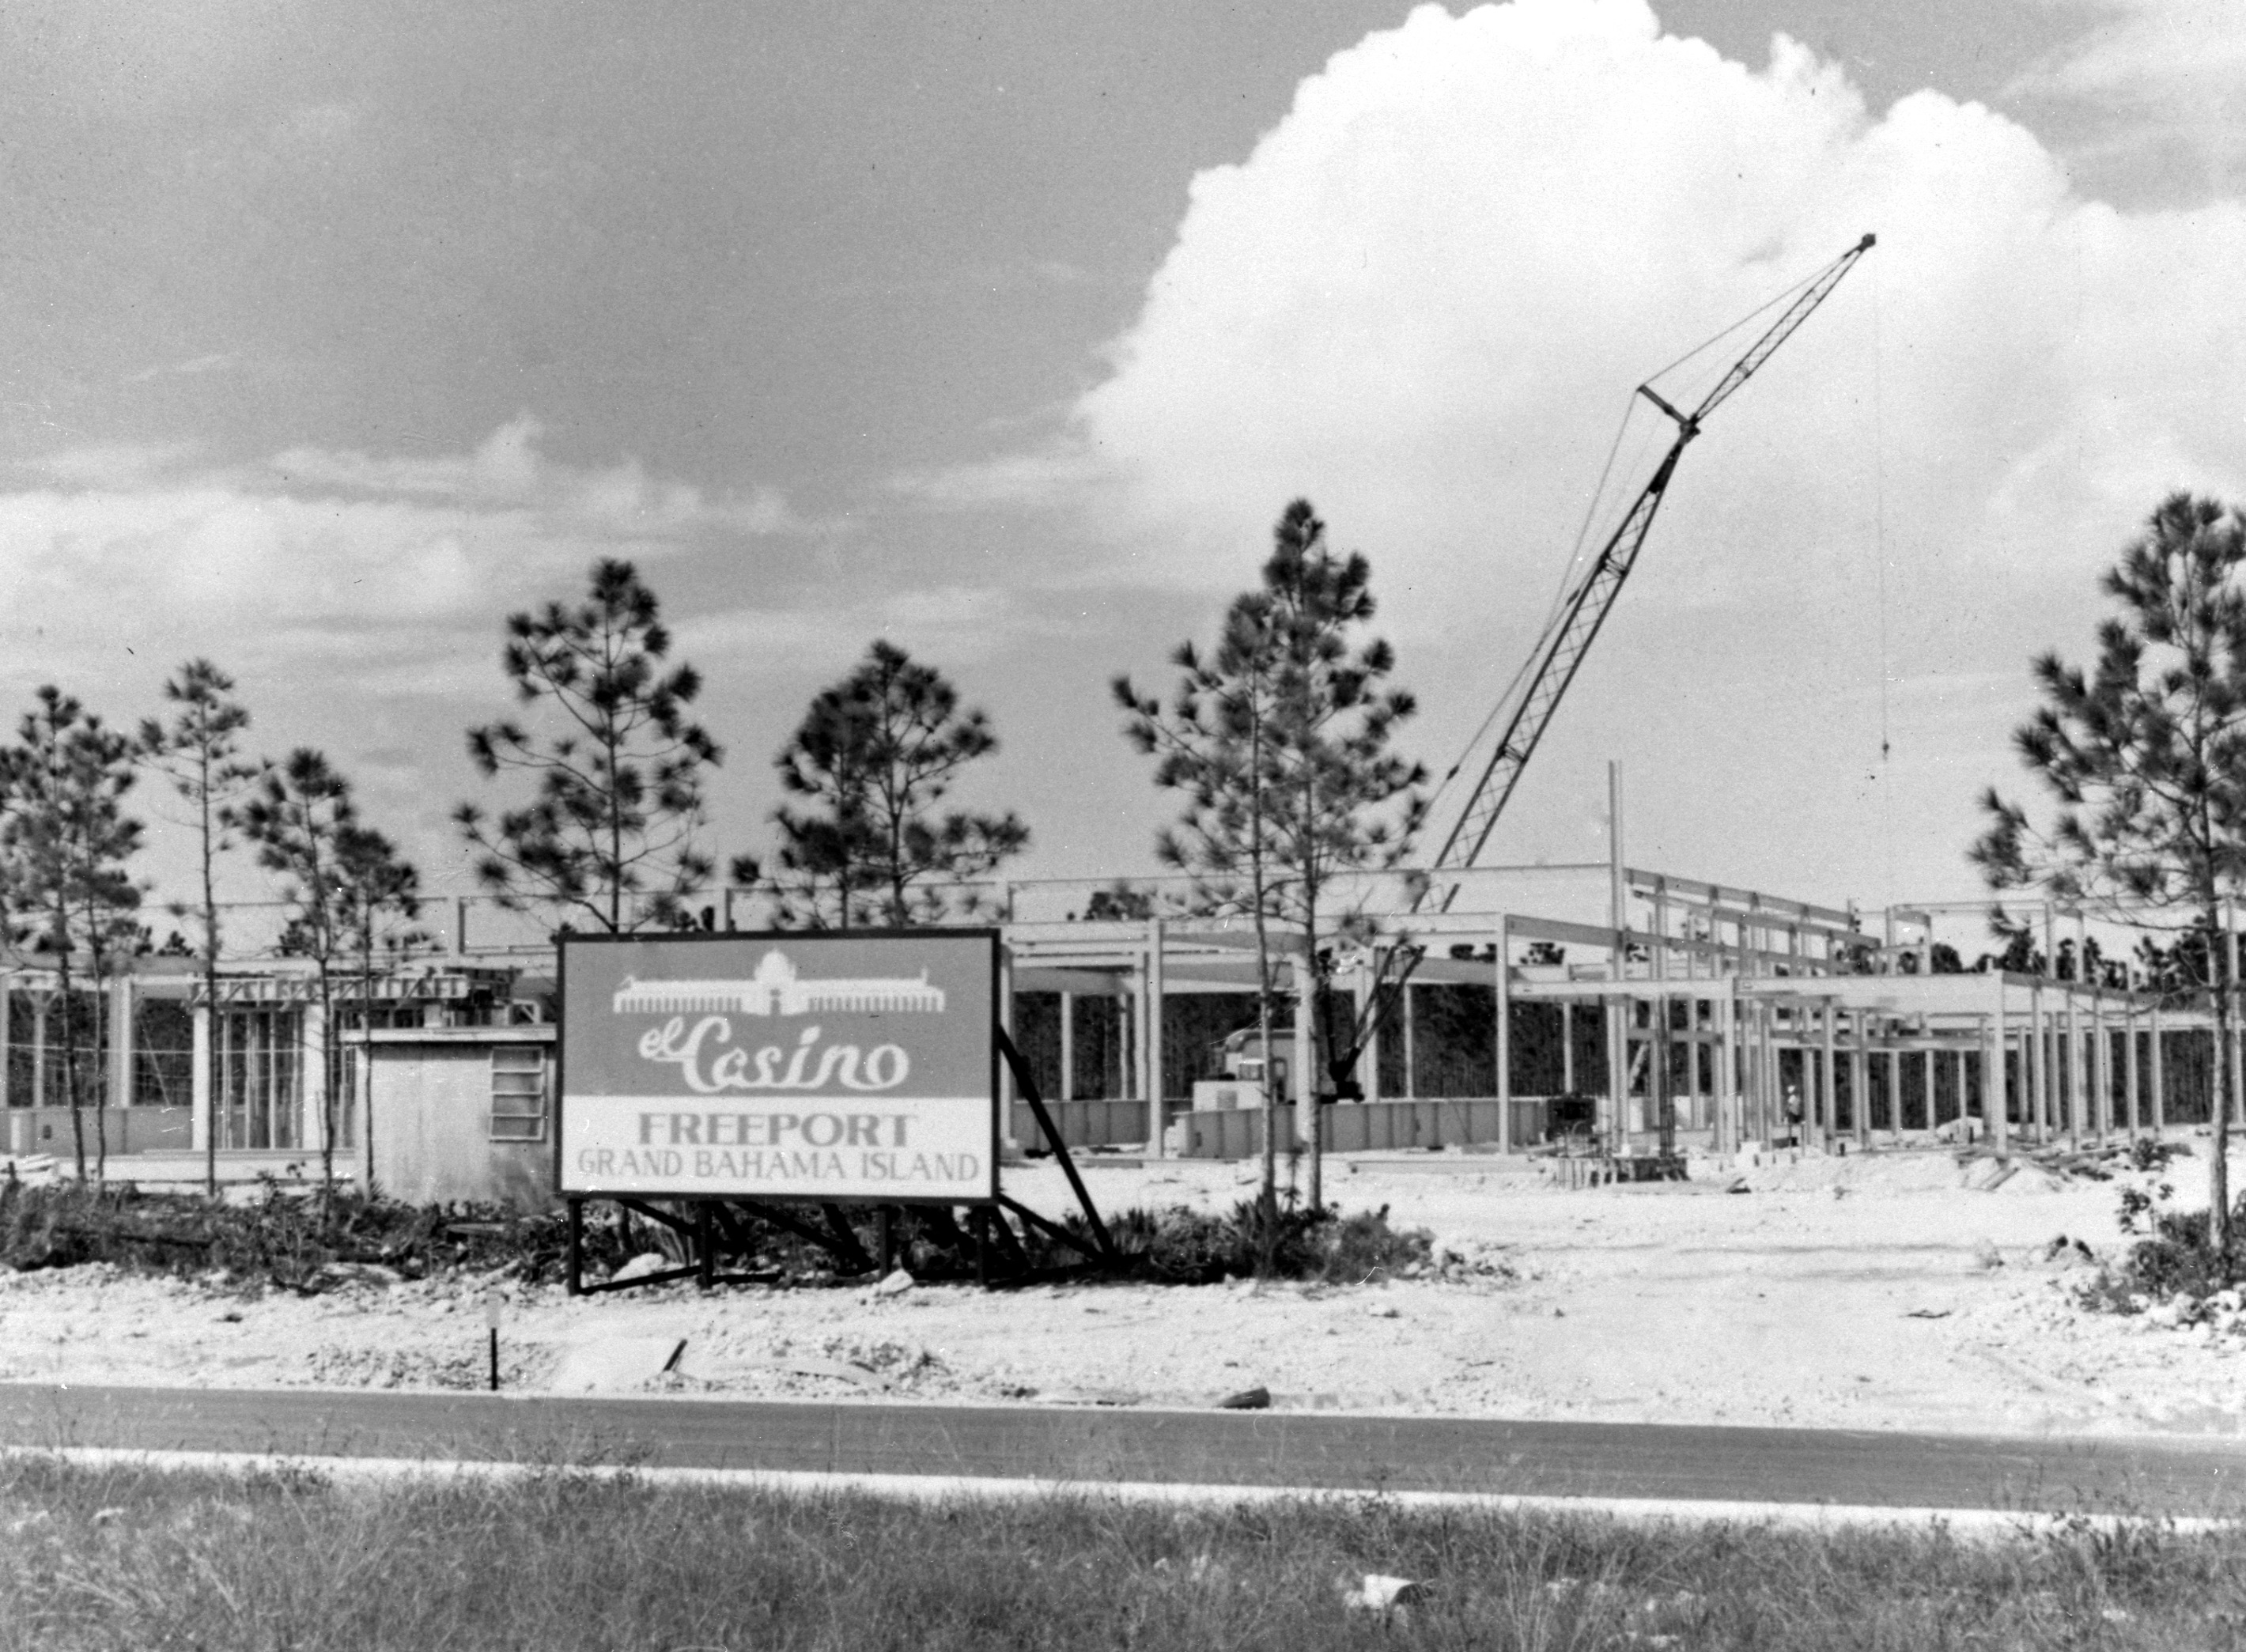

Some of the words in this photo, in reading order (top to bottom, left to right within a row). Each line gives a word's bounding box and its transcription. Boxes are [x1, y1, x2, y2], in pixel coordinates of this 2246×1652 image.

[639, 1016, 690, 1061] el
[682, 1016, 909, 1093] Casino
[637, 1113, 919, 1147] FREEPORT
[577, 1149, 683, 1178] GRAND
[695, 1150, 847, 1179] BAHAMA
[862, 1153, 979, 1182] ISLAND
